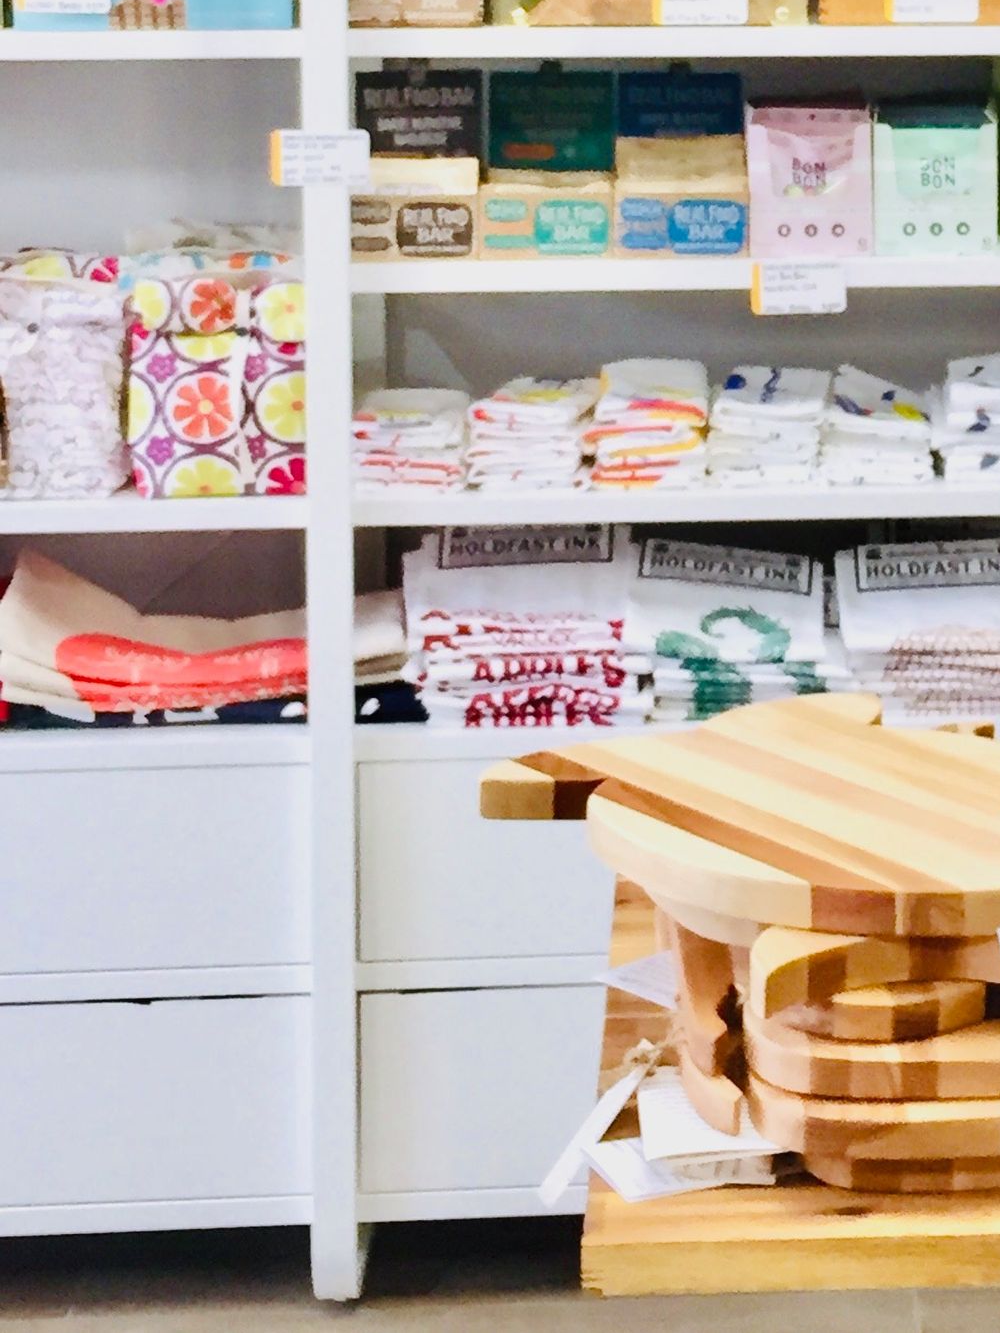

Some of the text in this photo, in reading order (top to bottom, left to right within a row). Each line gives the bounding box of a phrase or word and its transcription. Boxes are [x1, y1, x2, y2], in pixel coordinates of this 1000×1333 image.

[791, 157, 827, 174] BON
[920, 173, 955, 188] BON
[450, 533, 602, 556] HOLDFAST INK
[651, 553, 800, 583] HOLDFAST INK
[866, 559, 971, 579] HOLDFAST
